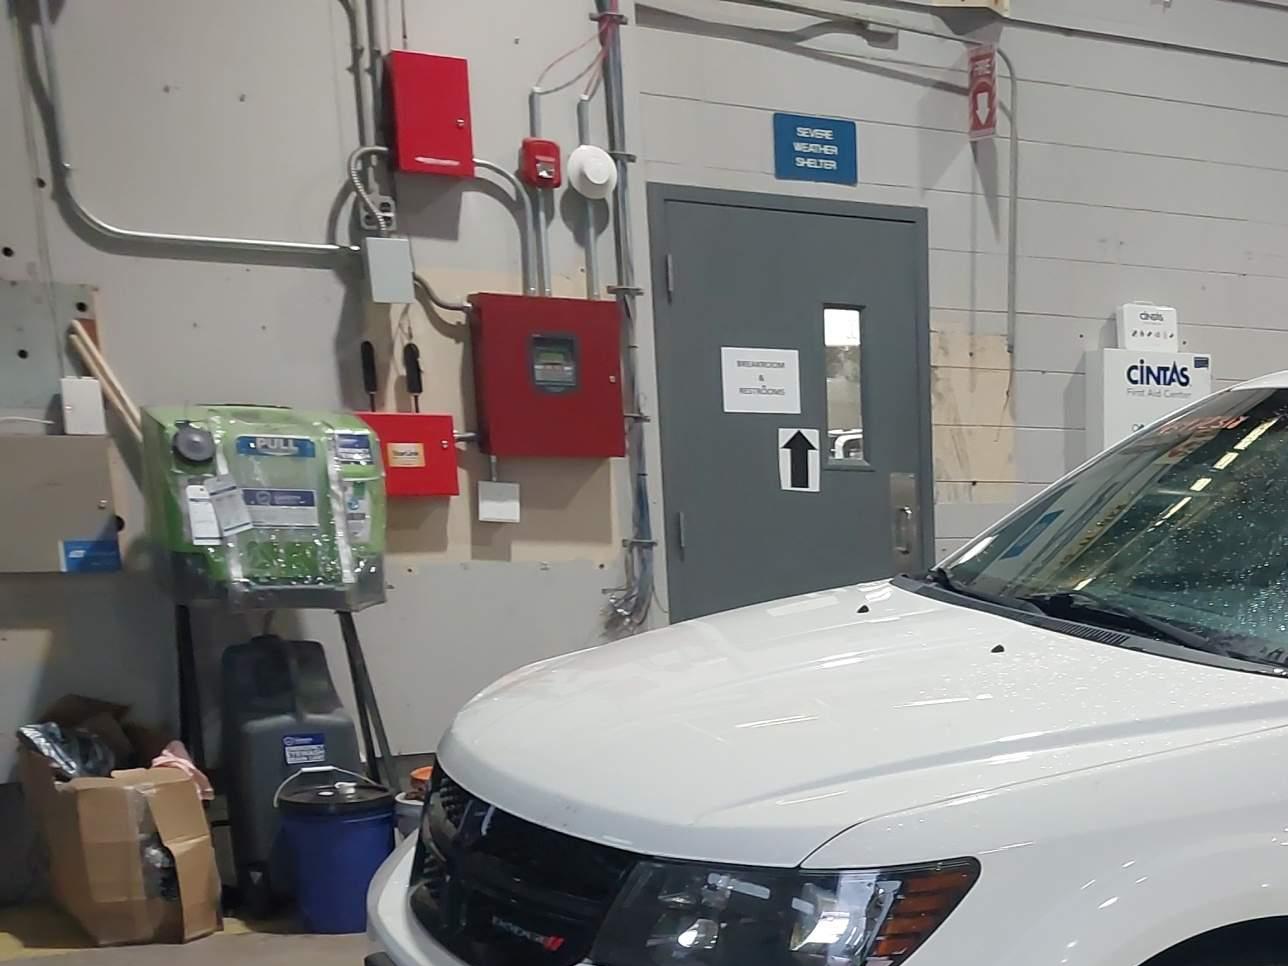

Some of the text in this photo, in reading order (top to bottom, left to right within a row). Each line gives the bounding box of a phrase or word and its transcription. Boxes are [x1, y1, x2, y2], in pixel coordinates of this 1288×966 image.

[795, 126, 834, 140] SEVERE
[792, 141, 839, 155] WEATHER
[794, 156, 838, 170] SHELTER
[1126, 358, 1190, 388] CINTAS
[738, 387, 786, 396] RESTROOMS
[255, 437, 300, 452] PULL
